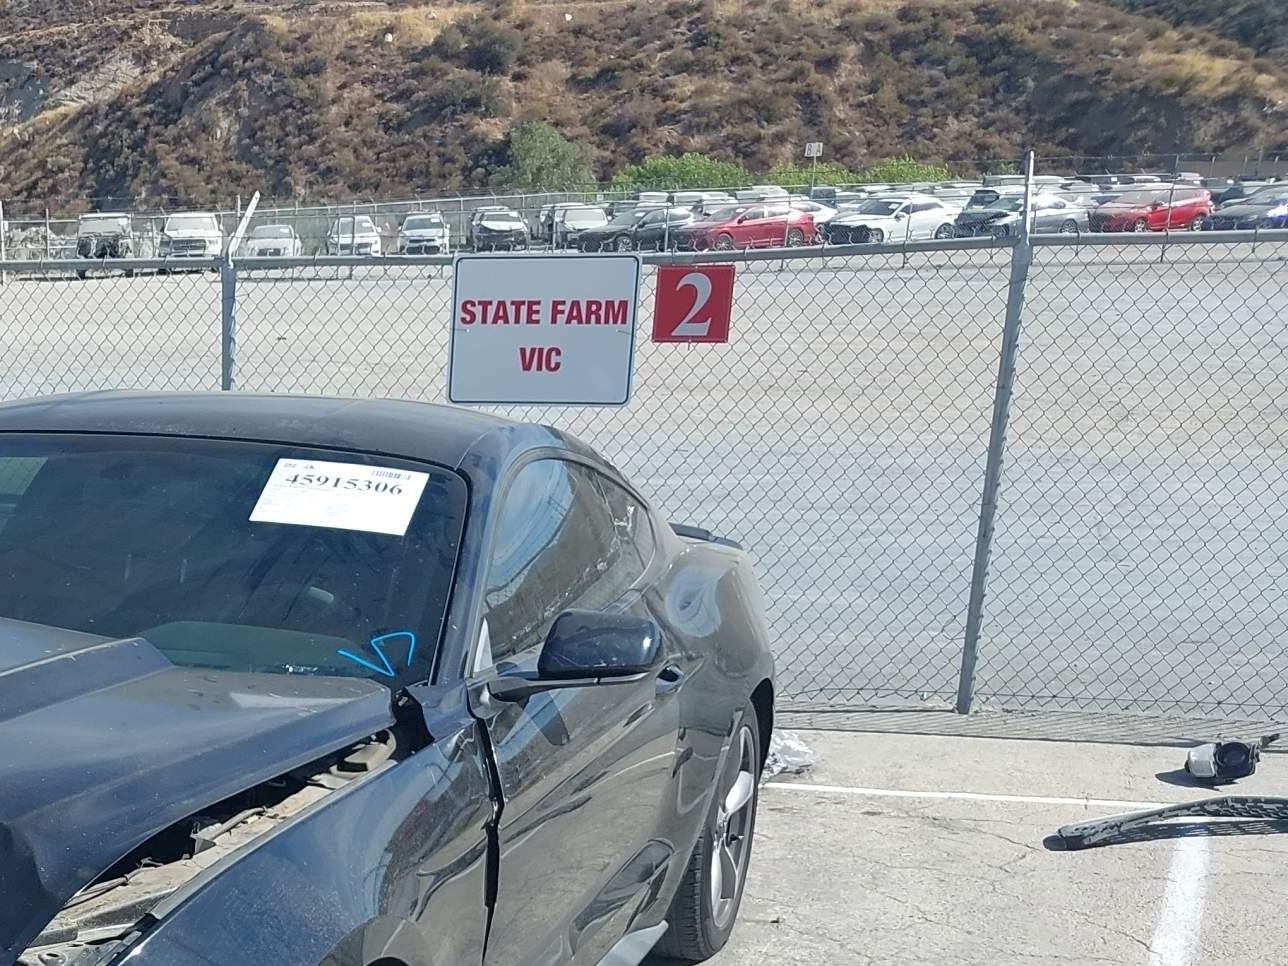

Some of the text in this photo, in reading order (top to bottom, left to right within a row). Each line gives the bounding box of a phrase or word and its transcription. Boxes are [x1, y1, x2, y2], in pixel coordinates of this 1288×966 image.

[460, 299, 629, 325] STATE FARM
[671, 272, 713, 337] 2
[519, 347, 562, 372] VIC
[285, 473, 404, 496] 45915306
